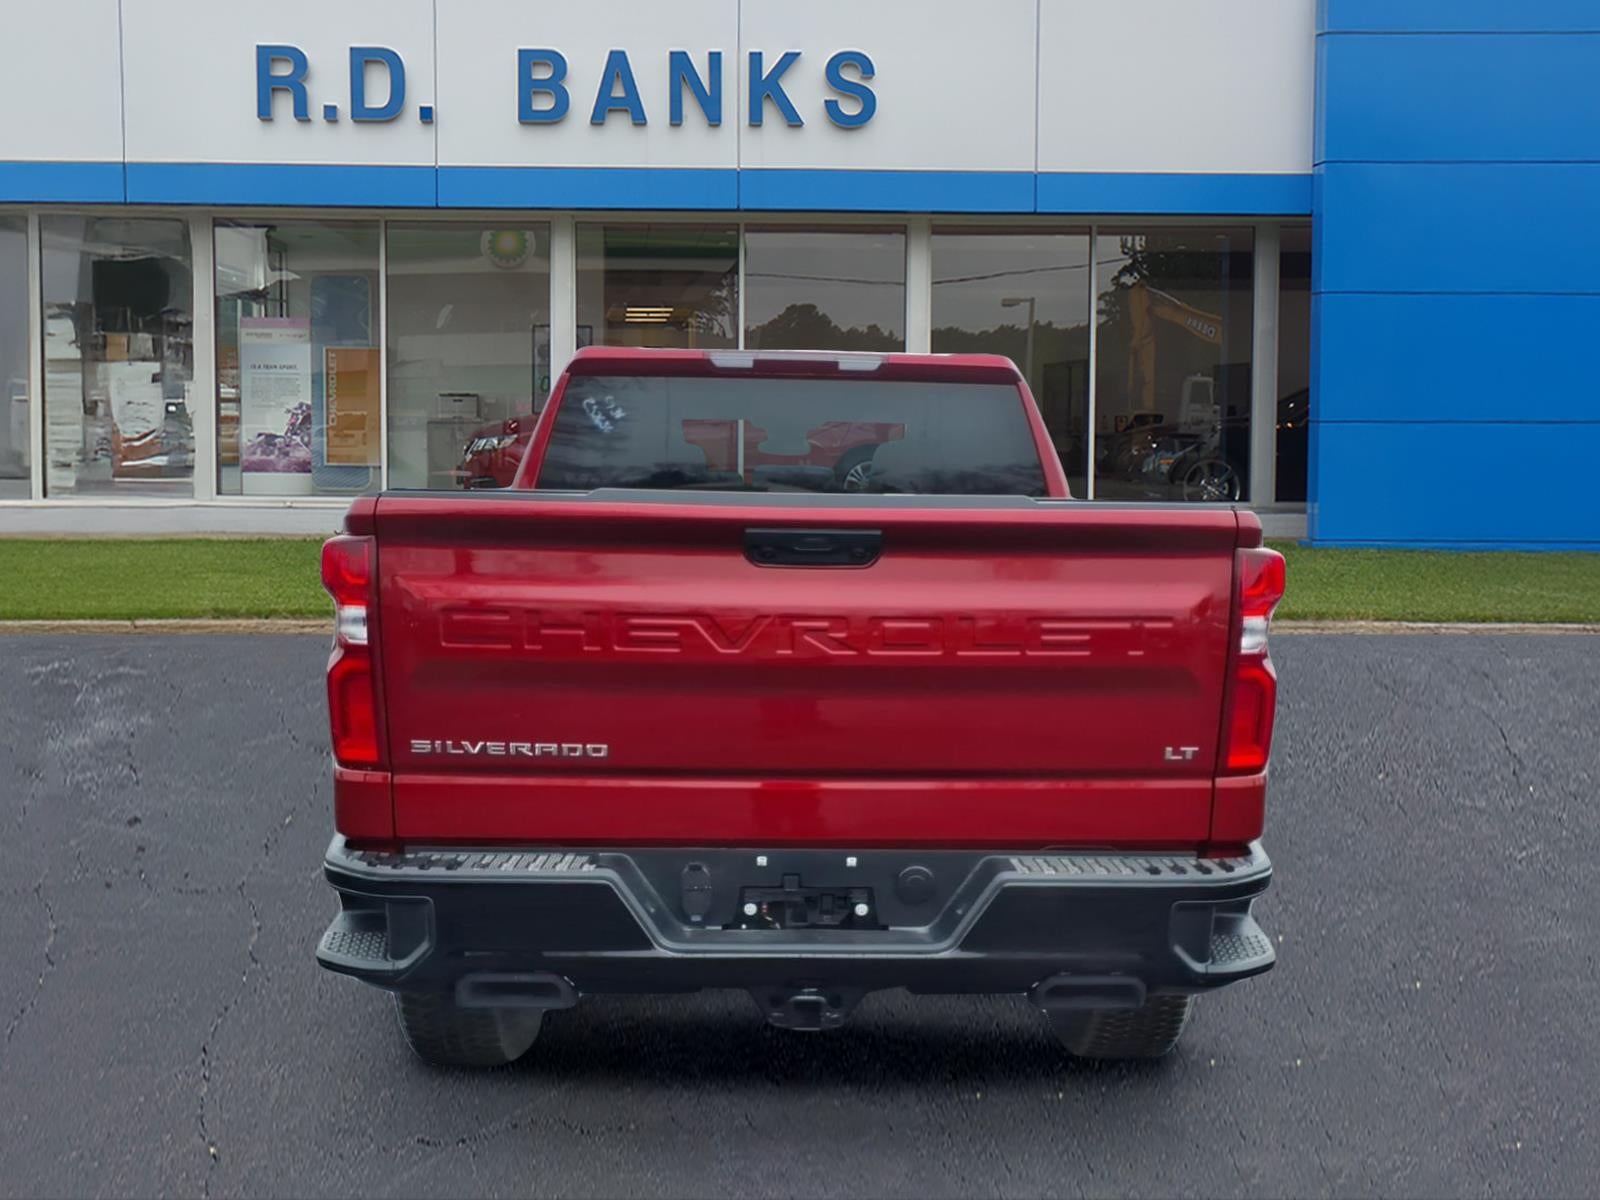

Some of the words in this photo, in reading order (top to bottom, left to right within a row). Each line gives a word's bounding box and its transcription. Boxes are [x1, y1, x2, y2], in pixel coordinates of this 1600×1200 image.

[255, 44, 434, 123] R.D.
[516, 47, 879, 129] BANKS
[439, 607, 1174, 655] CHEVROLET
[410, 739, 609, 758] SILVERADO
[1164, 746, 1199, 761] LT
